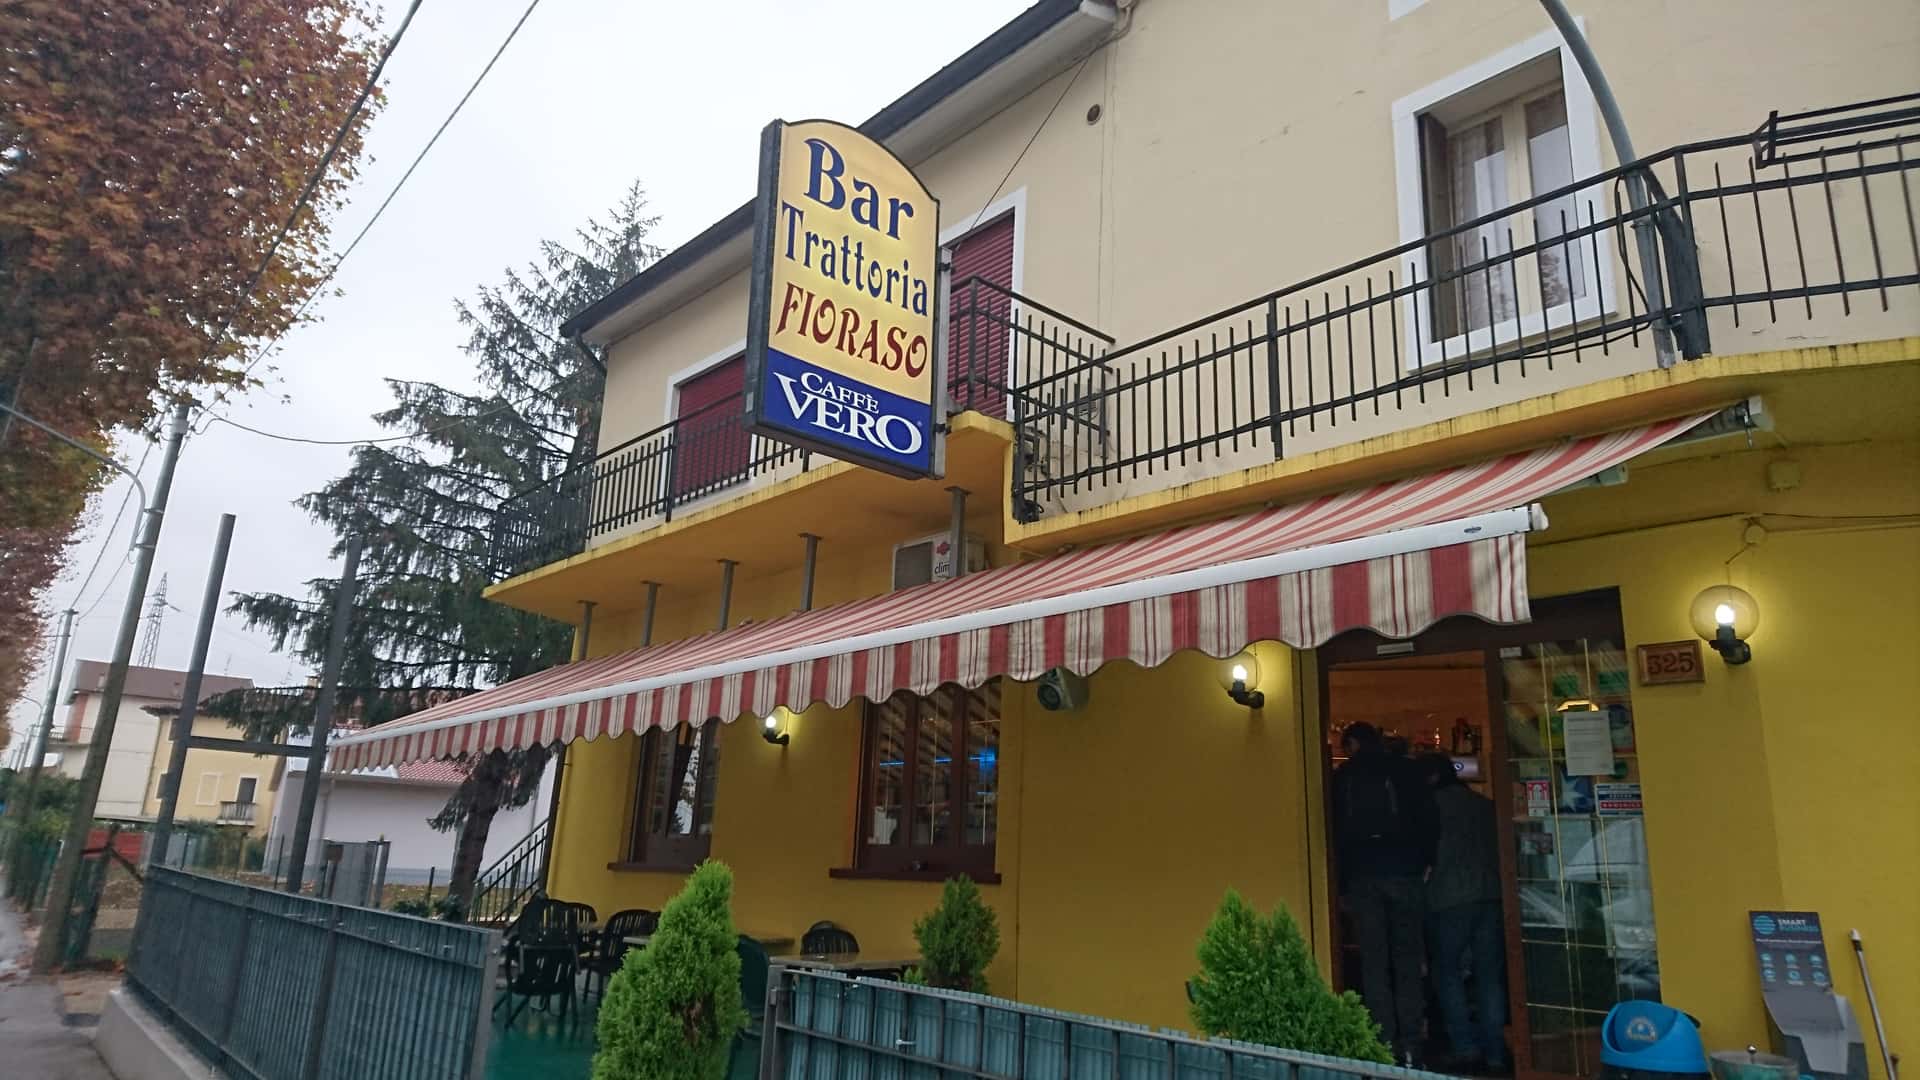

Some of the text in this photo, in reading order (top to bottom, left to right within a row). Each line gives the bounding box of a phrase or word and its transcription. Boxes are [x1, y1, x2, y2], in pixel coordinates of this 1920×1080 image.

[803, 138, 914, 240] Bar
[782, 200, 928, 316] Trattoria
[776, 282, 928, 378] FIORASO
[774, 372, 922, 455] VERO
[801, 372, 880, 414] CAFFÈ
[1647, 651, 1694, 674] 325
